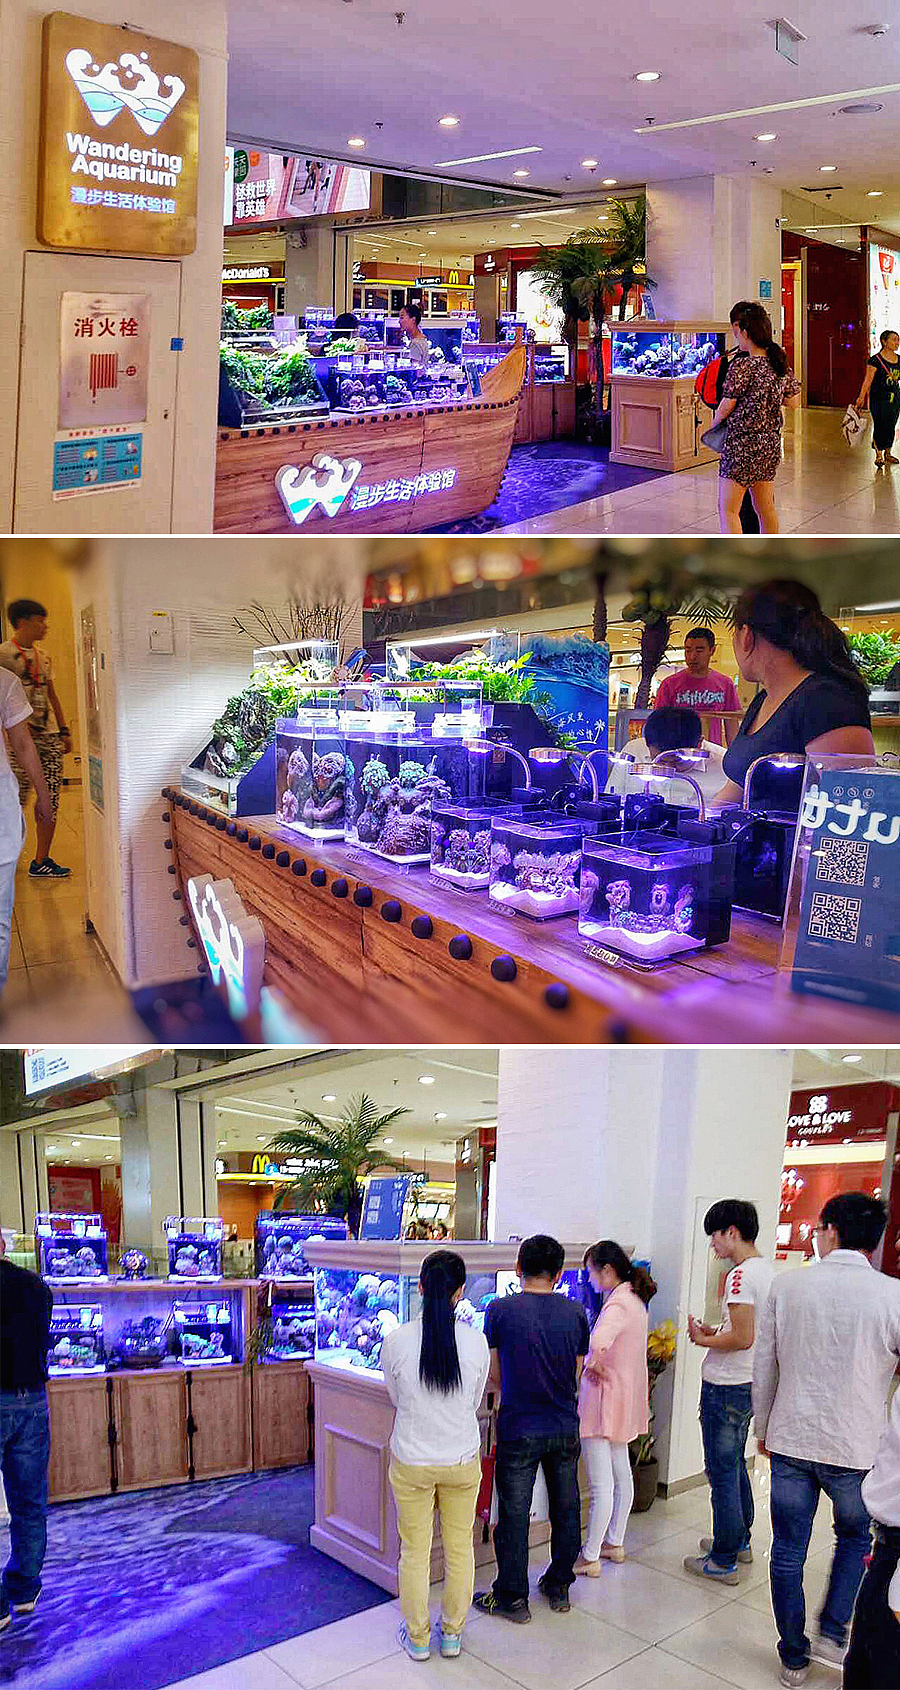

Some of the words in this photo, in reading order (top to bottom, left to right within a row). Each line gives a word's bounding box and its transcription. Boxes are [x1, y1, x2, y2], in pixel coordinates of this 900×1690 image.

[66, 132, 182, 174] Wandering
[71, 154, 177, 187] Aquarium
[70, 186, 176, 214] 漫步生活体验馆
[235, 178, 276, 202] 拯救世界
[73, 317, 139, 338] 消火栓
[351, 469, 456, 511] 漫步生活体验馆
[822, 1110, 852, 1124] LOVE
